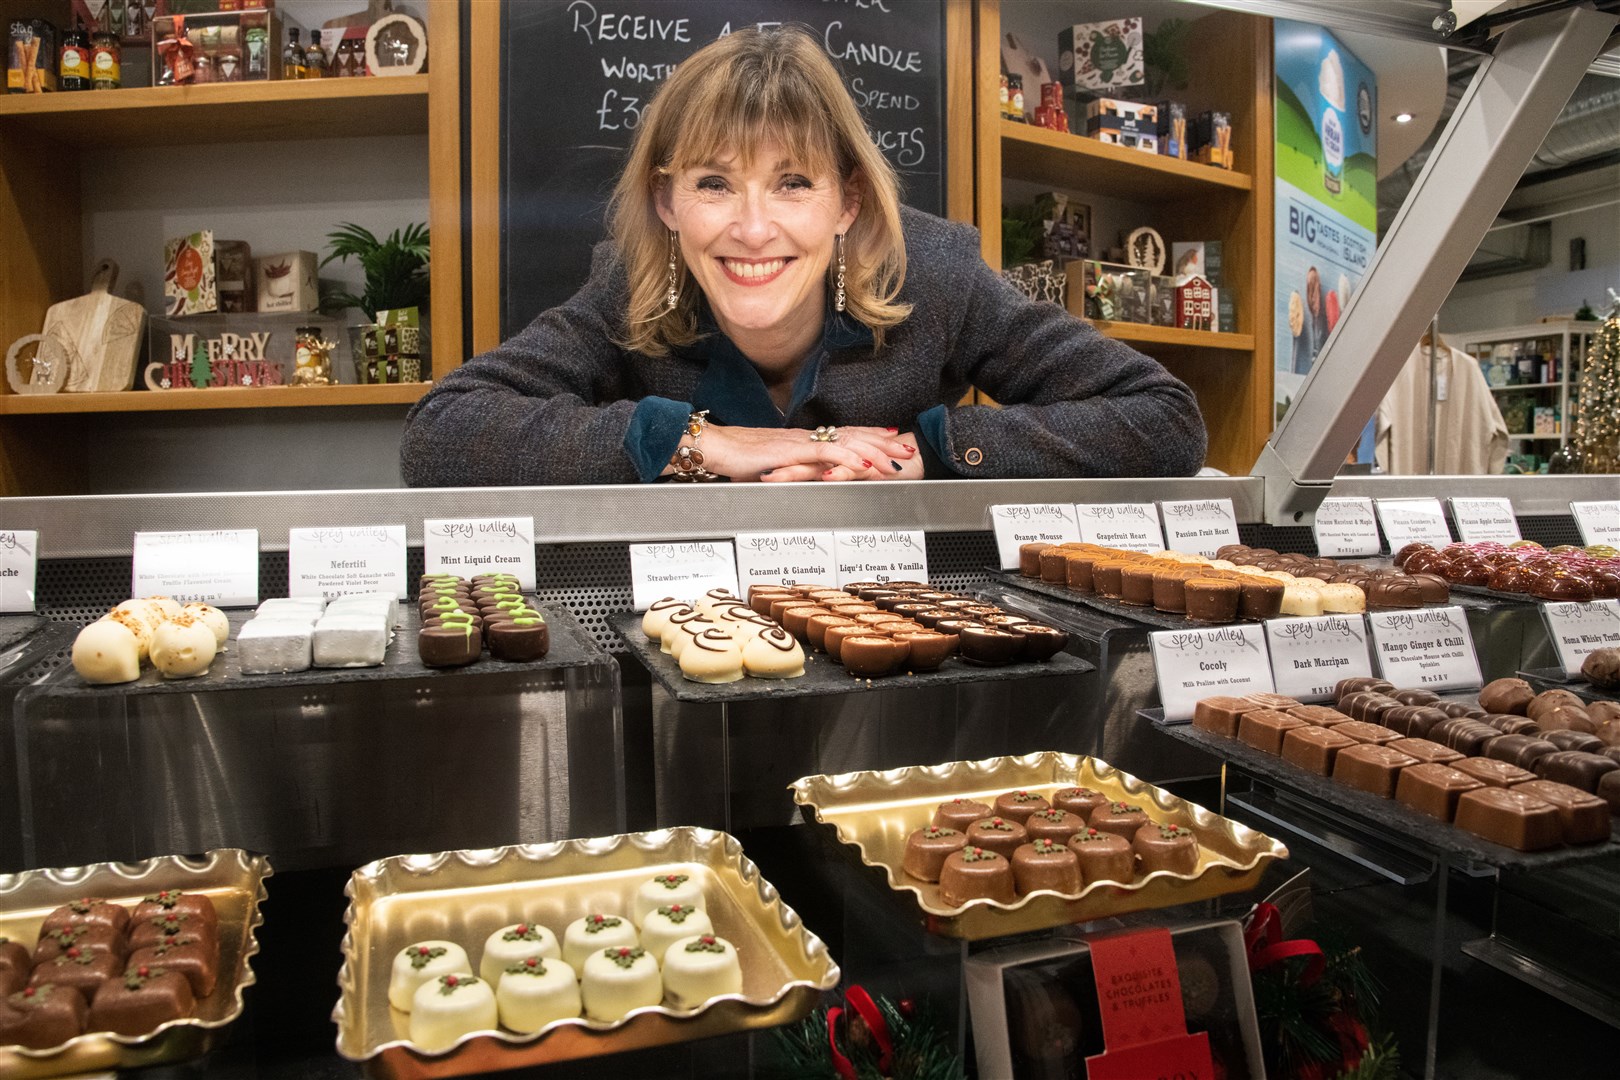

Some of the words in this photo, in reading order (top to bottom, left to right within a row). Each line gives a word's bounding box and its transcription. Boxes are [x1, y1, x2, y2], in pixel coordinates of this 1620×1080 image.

[10, 21, 33, 43] stag
[567, 0, 691, 45] RECEIVE
[825, 21, 921, 72] CANDLE
[601, 56, 676, 83] WORTH
[852, 78, 920, 110] SPEND
[868, 127, 925, 166] UCTS
[1289, 205, 1316, 243] BIG
[1316, 220, 1340, 244] TASTES
[170, 332, 271, 364] MERRY
[144, 360, 285, 390] CHRSTMAS
[1007, 507, 1030, 519] spey
[1034, 505, 1062, 518] valley
[1092, 506, 1114, 519] spey
[1117, 505, 1144, 519] valley
[1174, 504, 1193, 516] spey
[1196, 501, 1220, 514] valley
[443, 523, 473, 538] spey
[480, 521, 516, 537] valley
[1097, 533, 1128, 541] Grapefruit
[751, 536, 778, 551] spey
[783, 535, 817, 550] valley
[850, 534, 876, 548] spey
[880, 531, 912, 547] valley
[646, 544, 675, 558] spey
[680, 543, 714, 557] valley
[330, 560, 366, 568] Nefertiti
[441, 556, 460, 564] Mint
[464, 556, 491, 566] Liquid
[495, 555, 521, 563] Cream
[749, 567, 780, 576] Caramel
[792, 566, 826, 575] Gianduja
[1559, 603, 1582, 618] spey
[1583, 602, 1610, 616] valley
[1285, 621, 1313, 639] spey
[1317, 618, 1350, 636] valley
[1386, 614, 1414, 630] spey
[1417, 610, 1449, 627] valley
[1172, 632, 1203, 650] spey
[1208, 628, 1245, 646] valley
[1382, 641, 1407, 652] Mango
[1410, 640, 1434, 651] Ginger
[1437, 639, 1442, 647] &
[1444, 637, 1464, 647] Chilli
[1580, 634, 1602, 644] Whisky
[1200, 660, 1227, 672] Cocoly
[1294, 659, 1312, 669] Dark
[1314, 657, 1349, 668] Marzipan
[1111, 967, 1162, 985] EXQUISITE
[1106, 978, 1172, 1000] CHOCOLATES
[1112, 1002, 1118, 1012] &
[1124, 992, 1170, 1009] TRUFFLES
